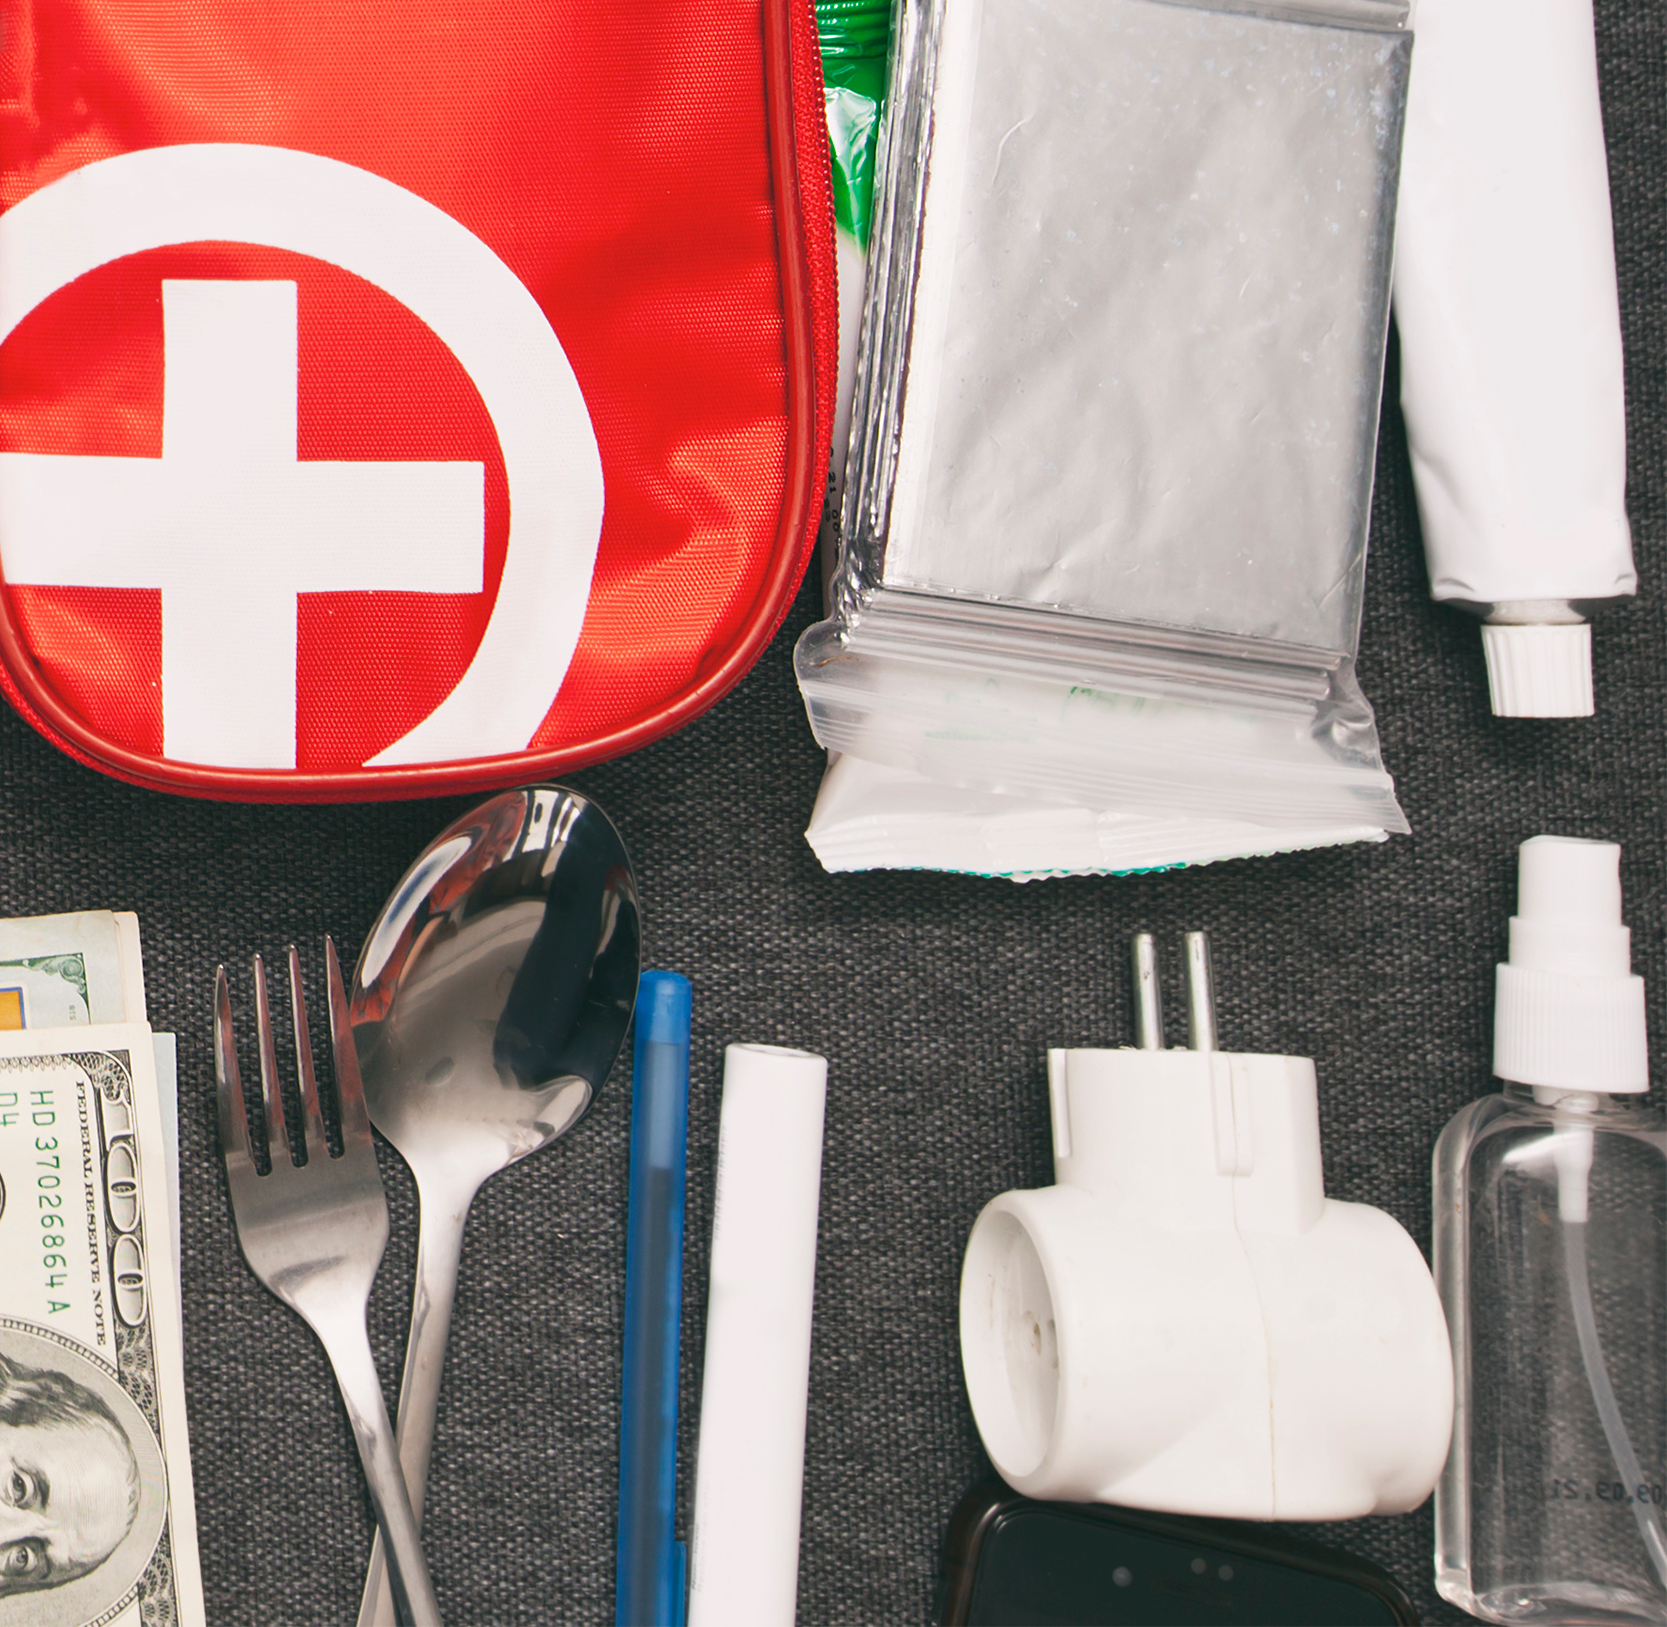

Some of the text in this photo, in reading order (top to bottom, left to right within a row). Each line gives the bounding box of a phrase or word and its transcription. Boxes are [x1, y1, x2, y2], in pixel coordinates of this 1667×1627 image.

[75, 1081, 106, 1345] FEDERAL RESERVE NOTE
